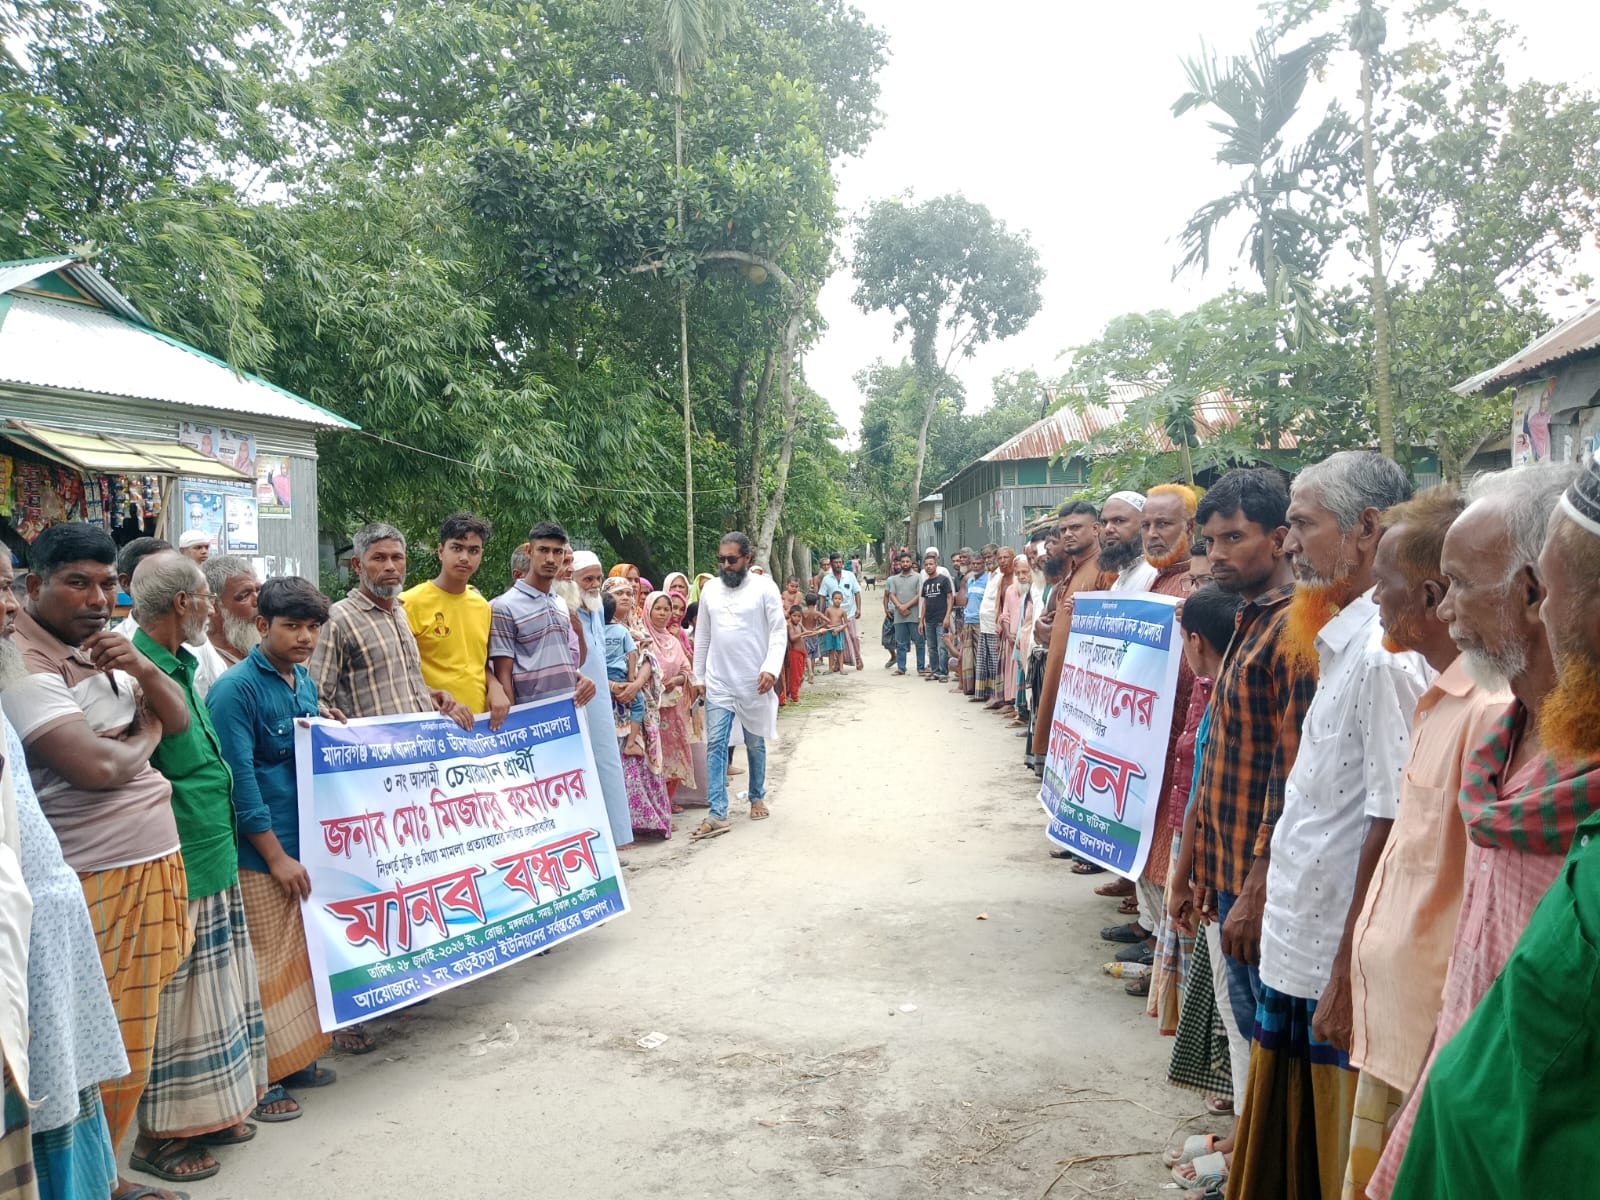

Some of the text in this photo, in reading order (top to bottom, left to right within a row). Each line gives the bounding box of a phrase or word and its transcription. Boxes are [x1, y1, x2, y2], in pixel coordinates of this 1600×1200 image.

[416, 734, 438, 757] মিথ্যা
[438, 739, 447, 754] ও
[496, 727, 528, 749] মাদক
[530, 716, 571, 738] মামলায়
[384, 746, 536, 793] ৩ নং আসামী চেয়ারম্যান প্রার্থী
[320, 768, 589, 860] জনাব মোঃ মিজানুর রহমানের
[1086, 813, 1110, 835] ঘটিকা
[399, 852, 414, 874] মুক্তি
[415, 855, 421, 866] ও
[421, 847, 439, 865] মিথ্যা
[439, 843, 465, 860] মামলা
[466, 832, 506, 854] প্রত্যাহারের
[1080, 830, 1116, 859] জনগণ
[323, 828, 602, 956] মানব বন্ধন
[397, 957, 411, 972] ২৮
[571, 897, 578, 906] ৩
[578, 887, 598, 902] ঘটিকা
[422, 972, 435, 987] ২
[432, 966, 453, 983] নং
[450, 945, 499, 976] কড়ইচড়া
[498, 926, 546, 957] ইউনিয়নের
[547, 915, 582, 938] সর্বস্তরের
[582, 900, 609, 921] জনগণ
